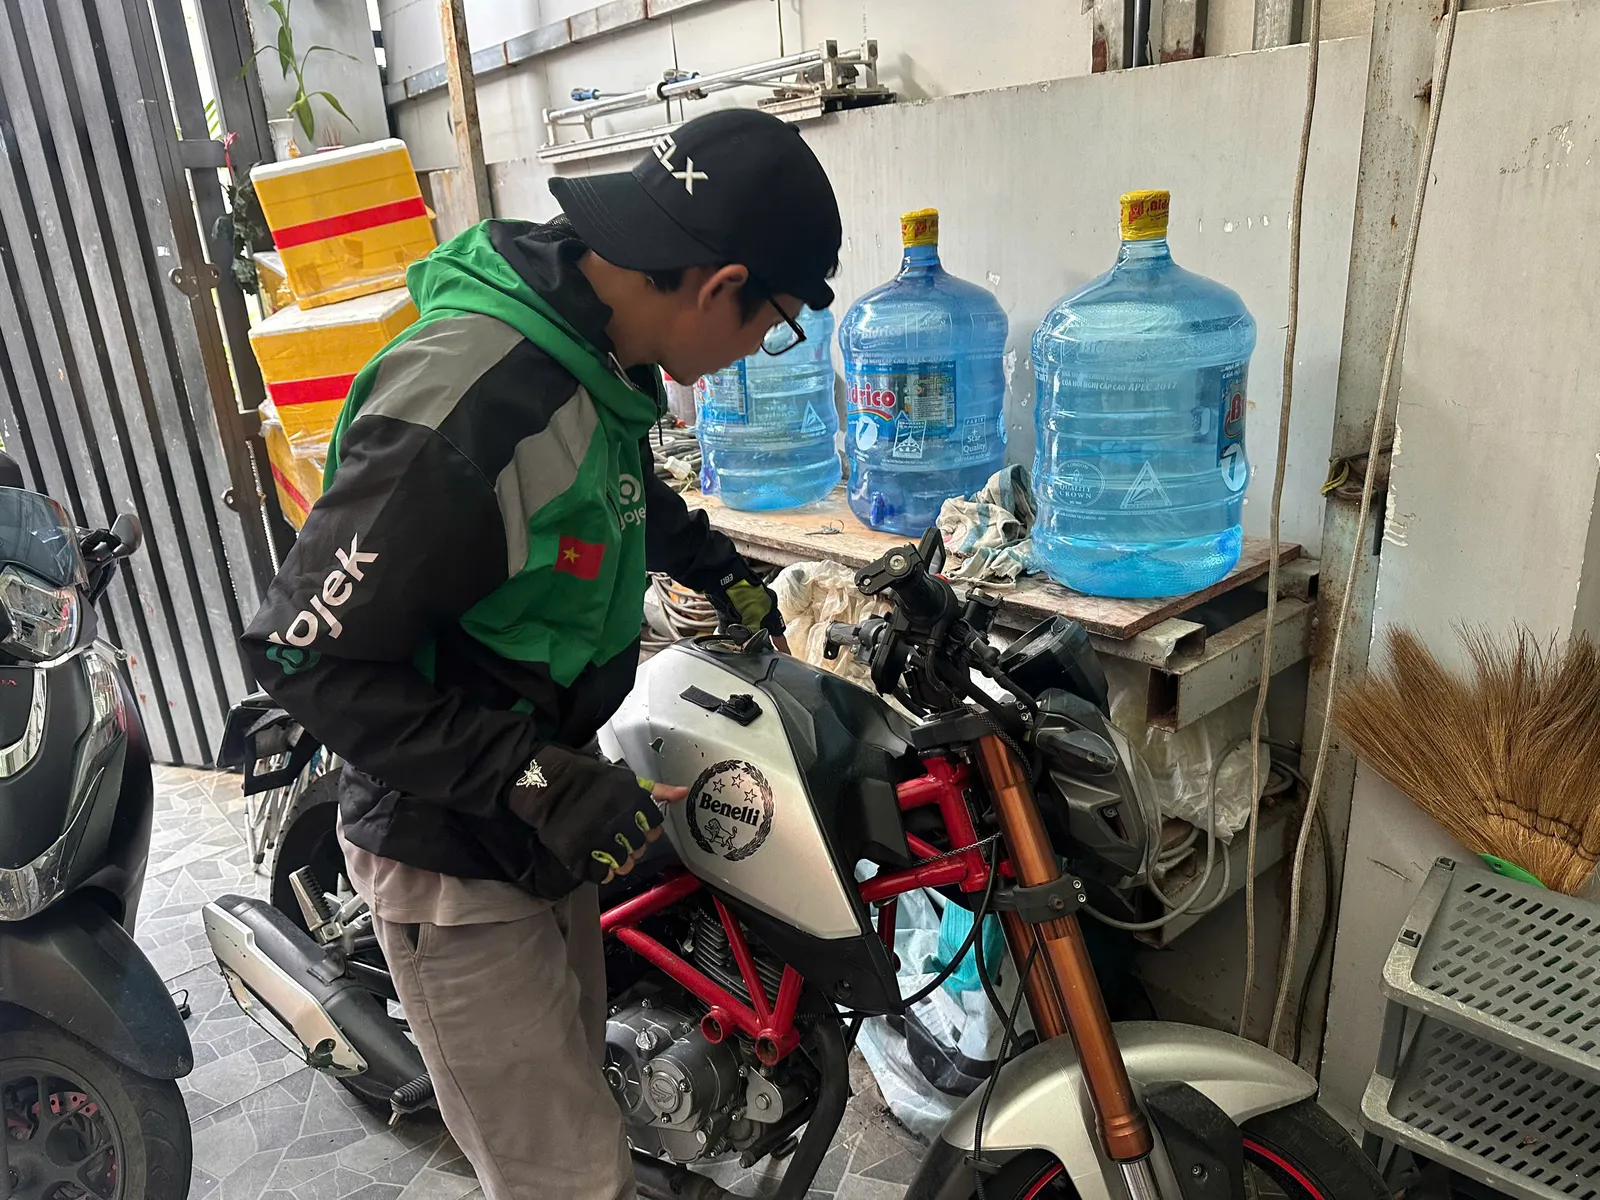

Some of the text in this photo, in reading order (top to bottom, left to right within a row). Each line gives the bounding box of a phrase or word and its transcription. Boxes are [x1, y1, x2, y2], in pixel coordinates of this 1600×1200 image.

[1128, 383, 1152, 392] APEC
[1154, 381, 1178, 391] 2017
[967, 435, 982, 443] Star
[963, 443, 986, 453] Quality
[1059, 484, 1092, 493] QUALITY
[1059, 490, 1092, 499] CROWN
[266, 532, 379, 647] ojek
[699, 791, 761, 827] Benelli
